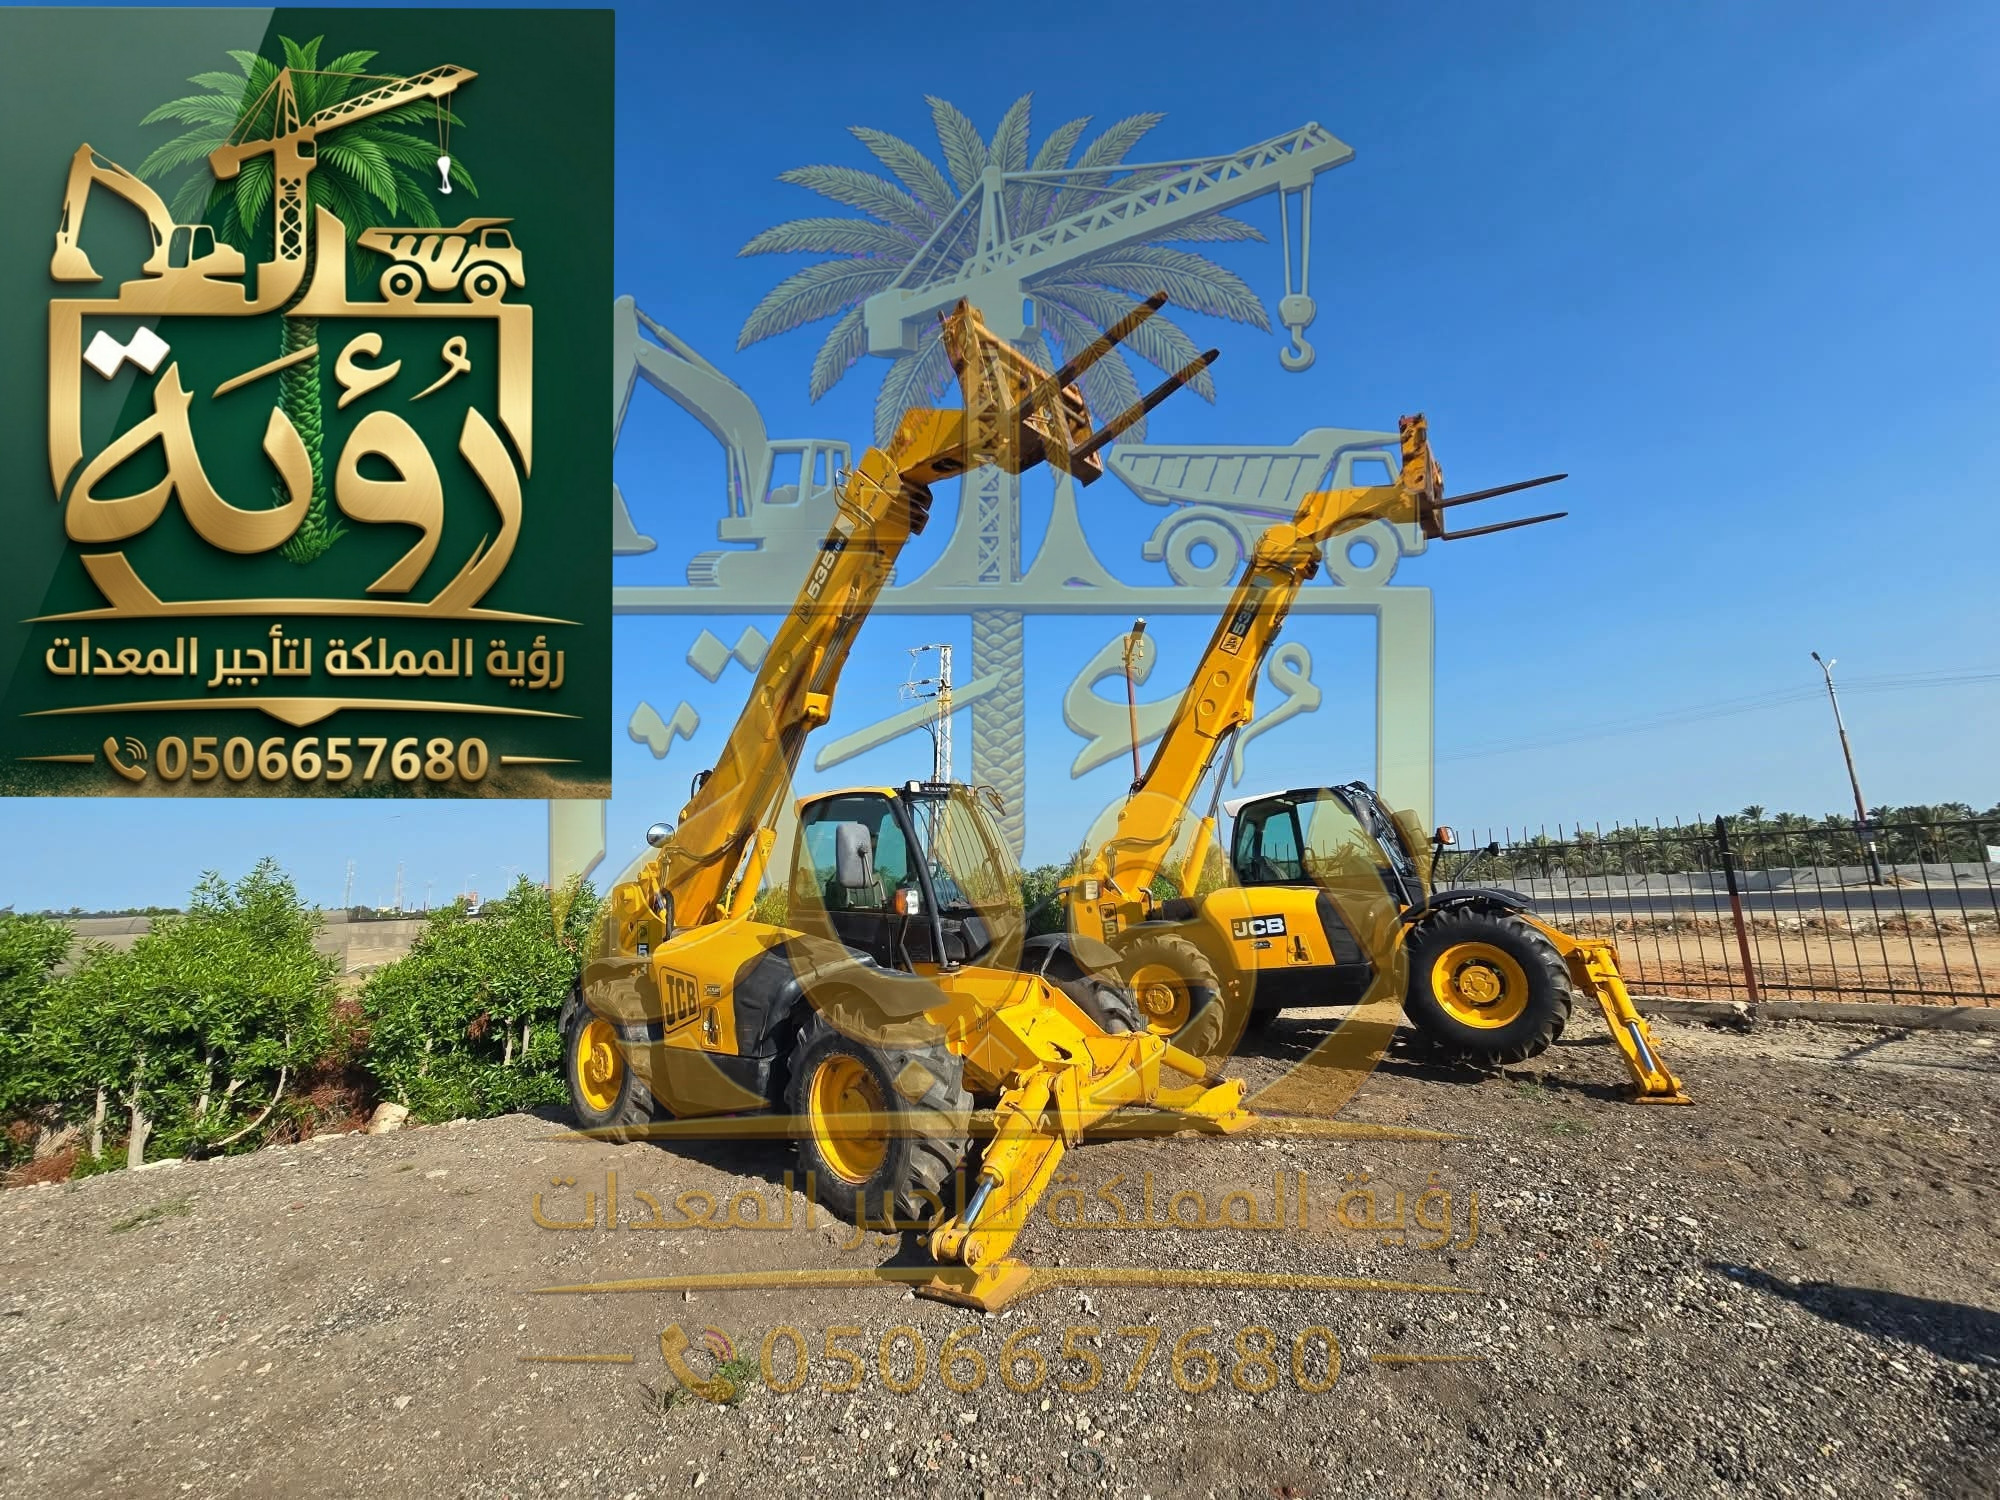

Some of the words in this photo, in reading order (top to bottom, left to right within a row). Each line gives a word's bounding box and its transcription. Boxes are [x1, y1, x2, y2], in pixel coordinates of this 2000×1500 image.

[807, 551, 836, 600] 535
[1232, 599, 1258, 636] 535
[1233, 917, 1285, 937] JCB
[664, 974, 697, 1026] JCB
